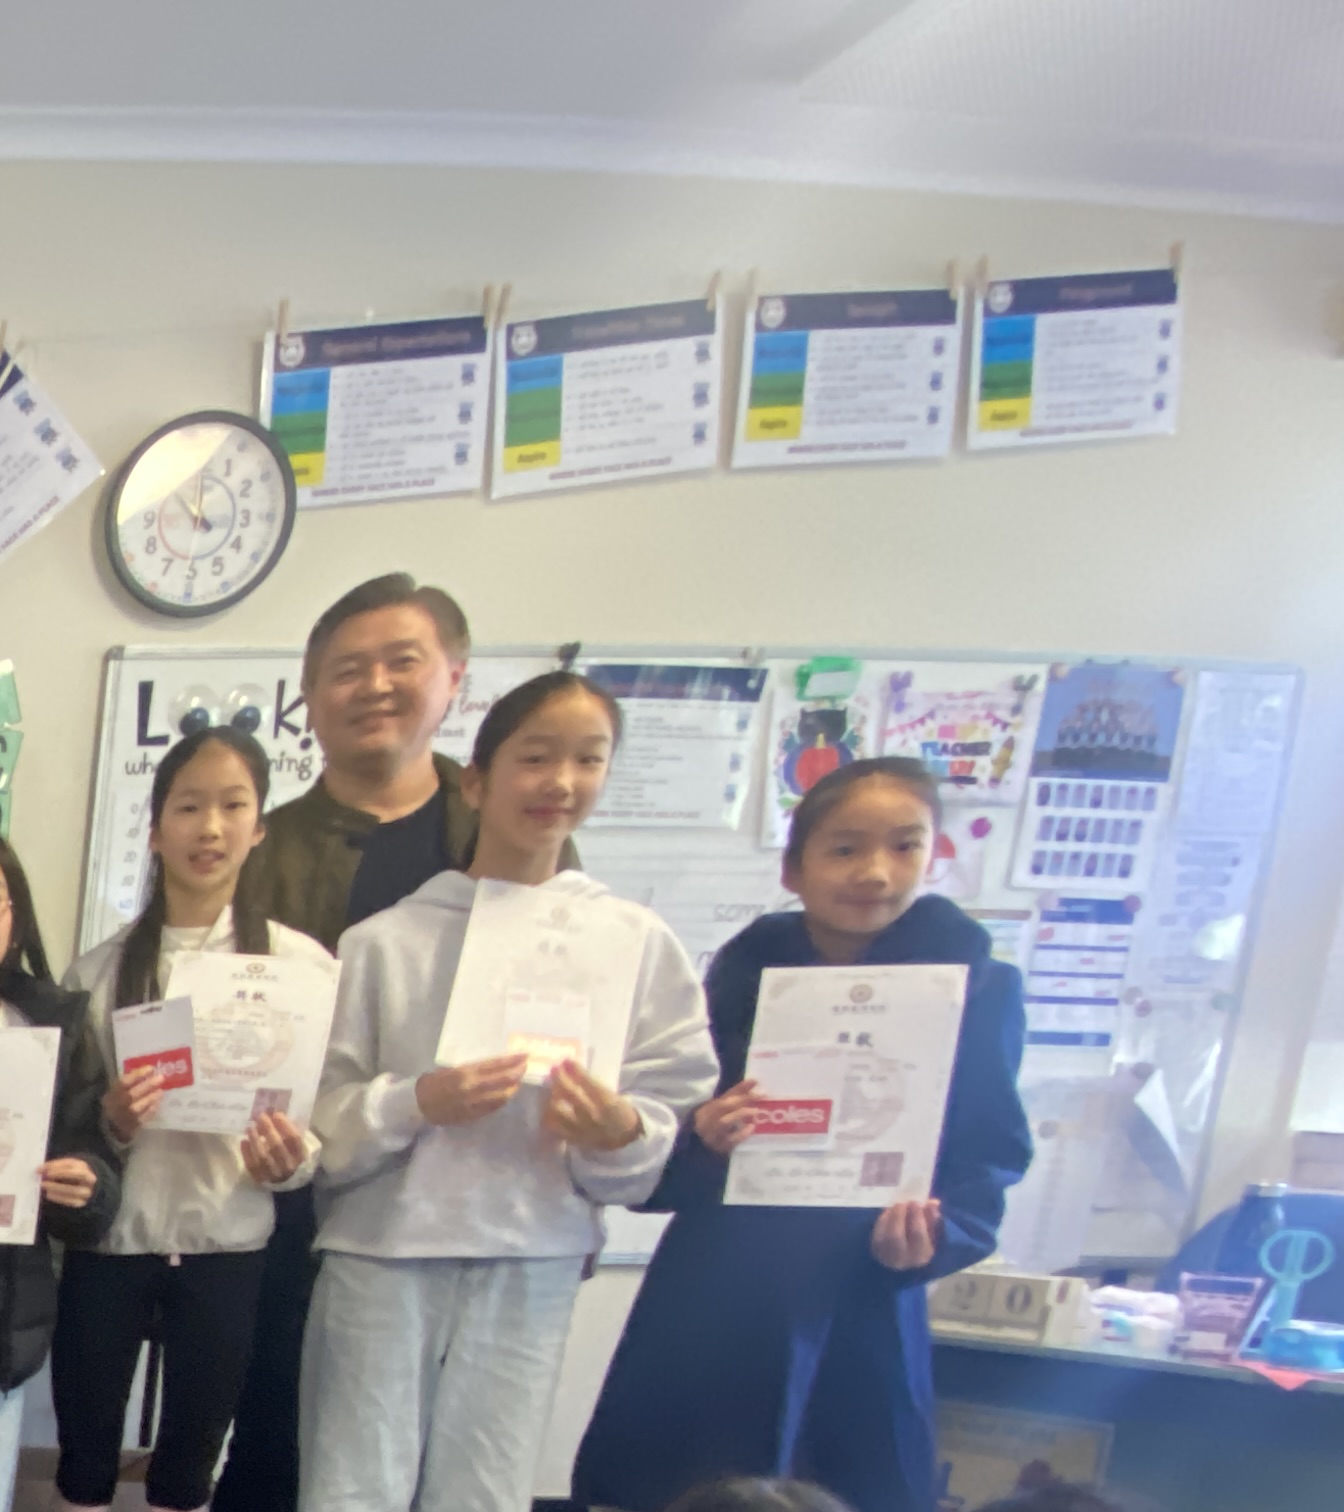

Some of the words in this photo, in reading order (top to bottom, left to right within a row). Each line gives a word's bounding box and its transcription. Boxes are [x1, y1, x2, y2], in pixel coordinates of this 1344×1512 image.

[224, 458, 233, 478] 1
[239, 479, 254, 499] 2
[143, 510, 156, 530] 9
[239, 509, 251, 529] 3
[144, 536, 158, 555] 8
[229, 535, 243, 553] 4
[161, 557, 174, 577] 7
[211, 556, 225, 577] 5
[753, 1103, 826, 1125] coles
